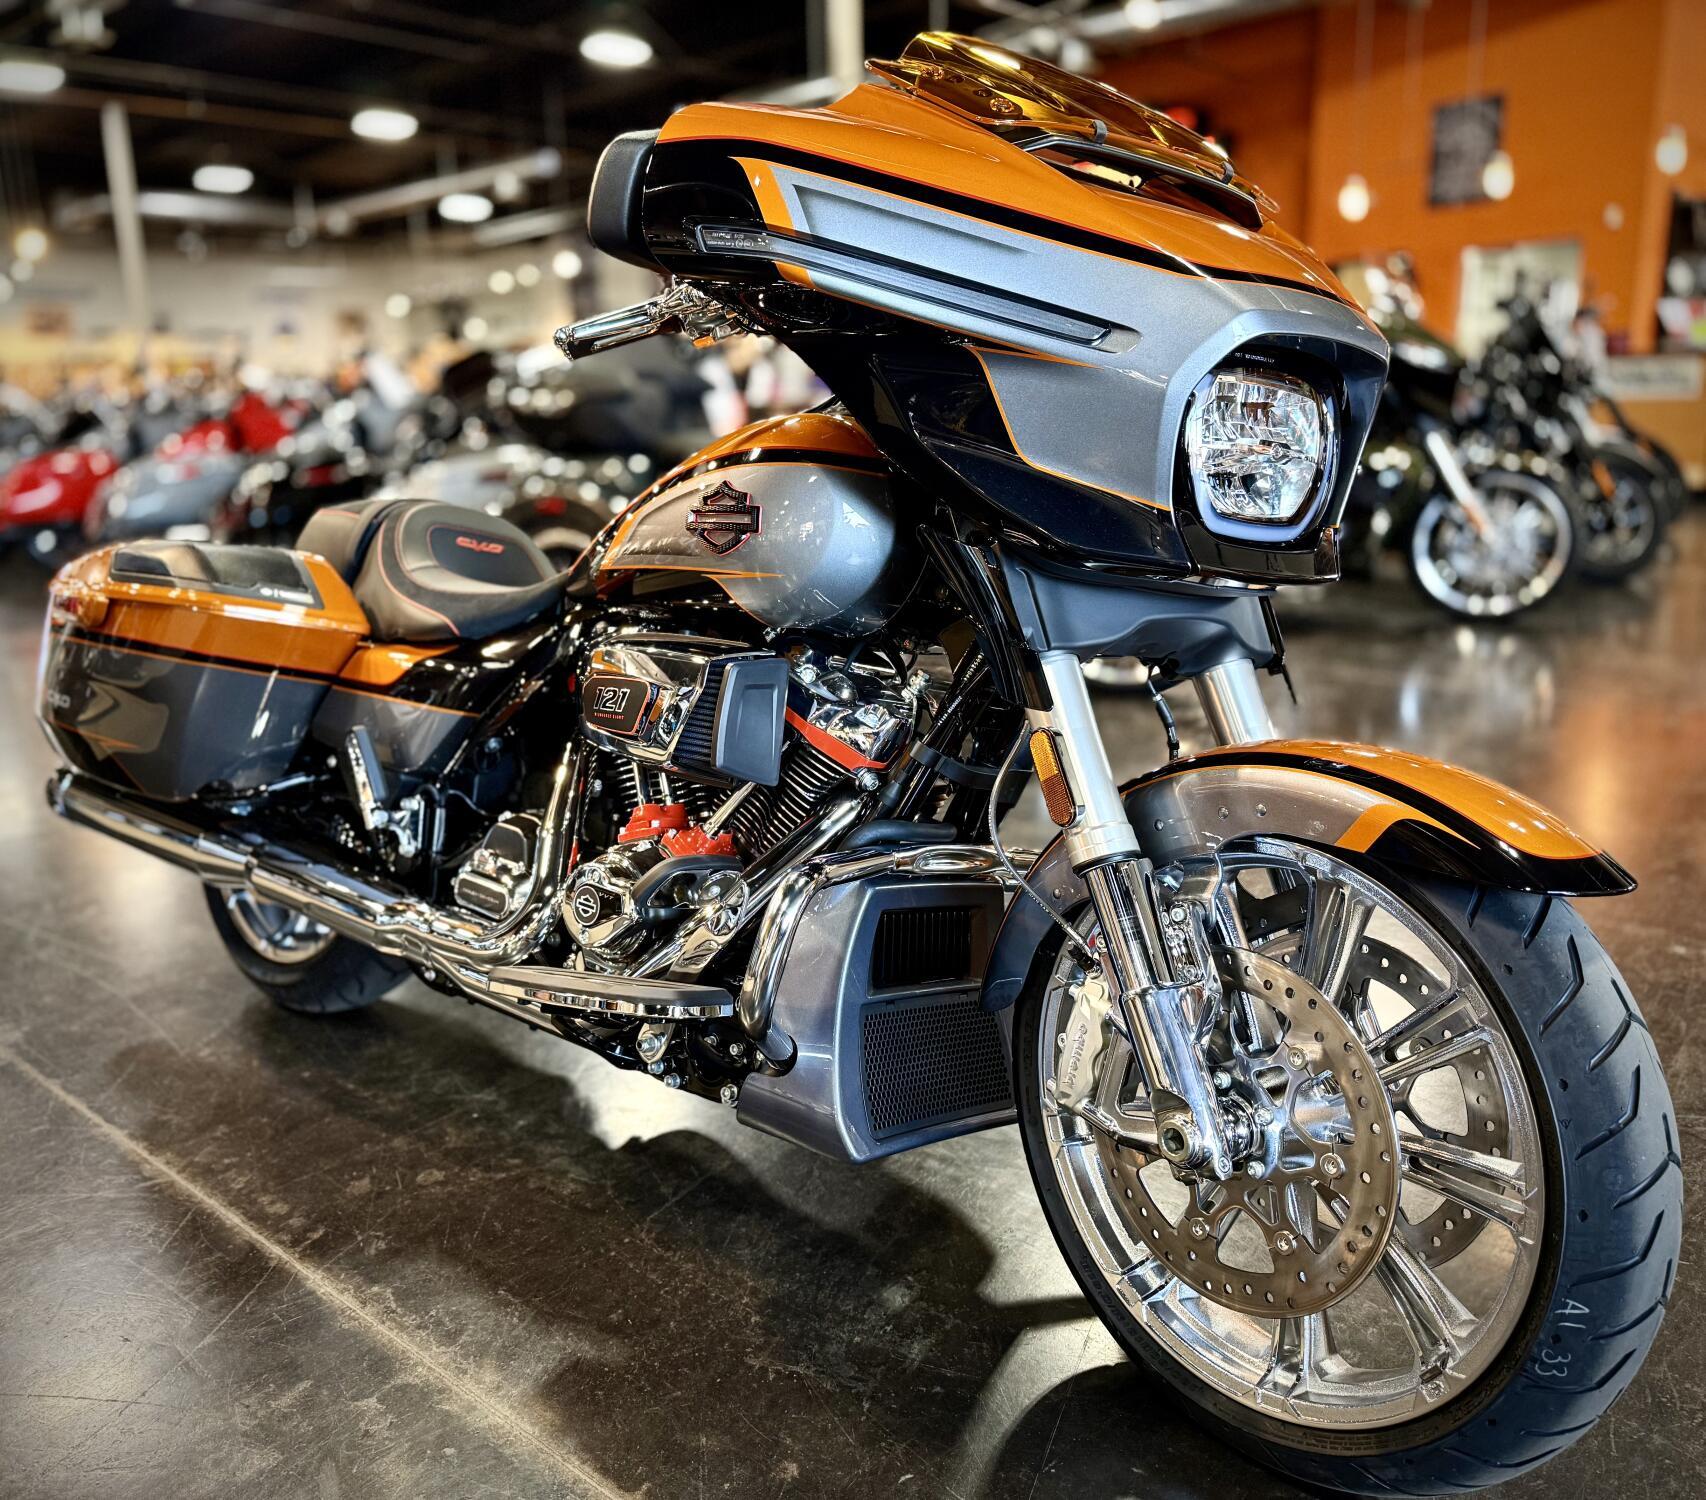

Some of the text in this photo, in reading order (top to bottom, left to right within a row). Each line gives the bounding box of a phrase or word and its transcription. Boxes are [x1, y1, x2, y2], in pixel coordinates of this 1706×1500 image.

[456, 536, 504, 554] CVO
[593, 686, 631, 712] 121
[1062, 1023, 1088, 1088] brembo
